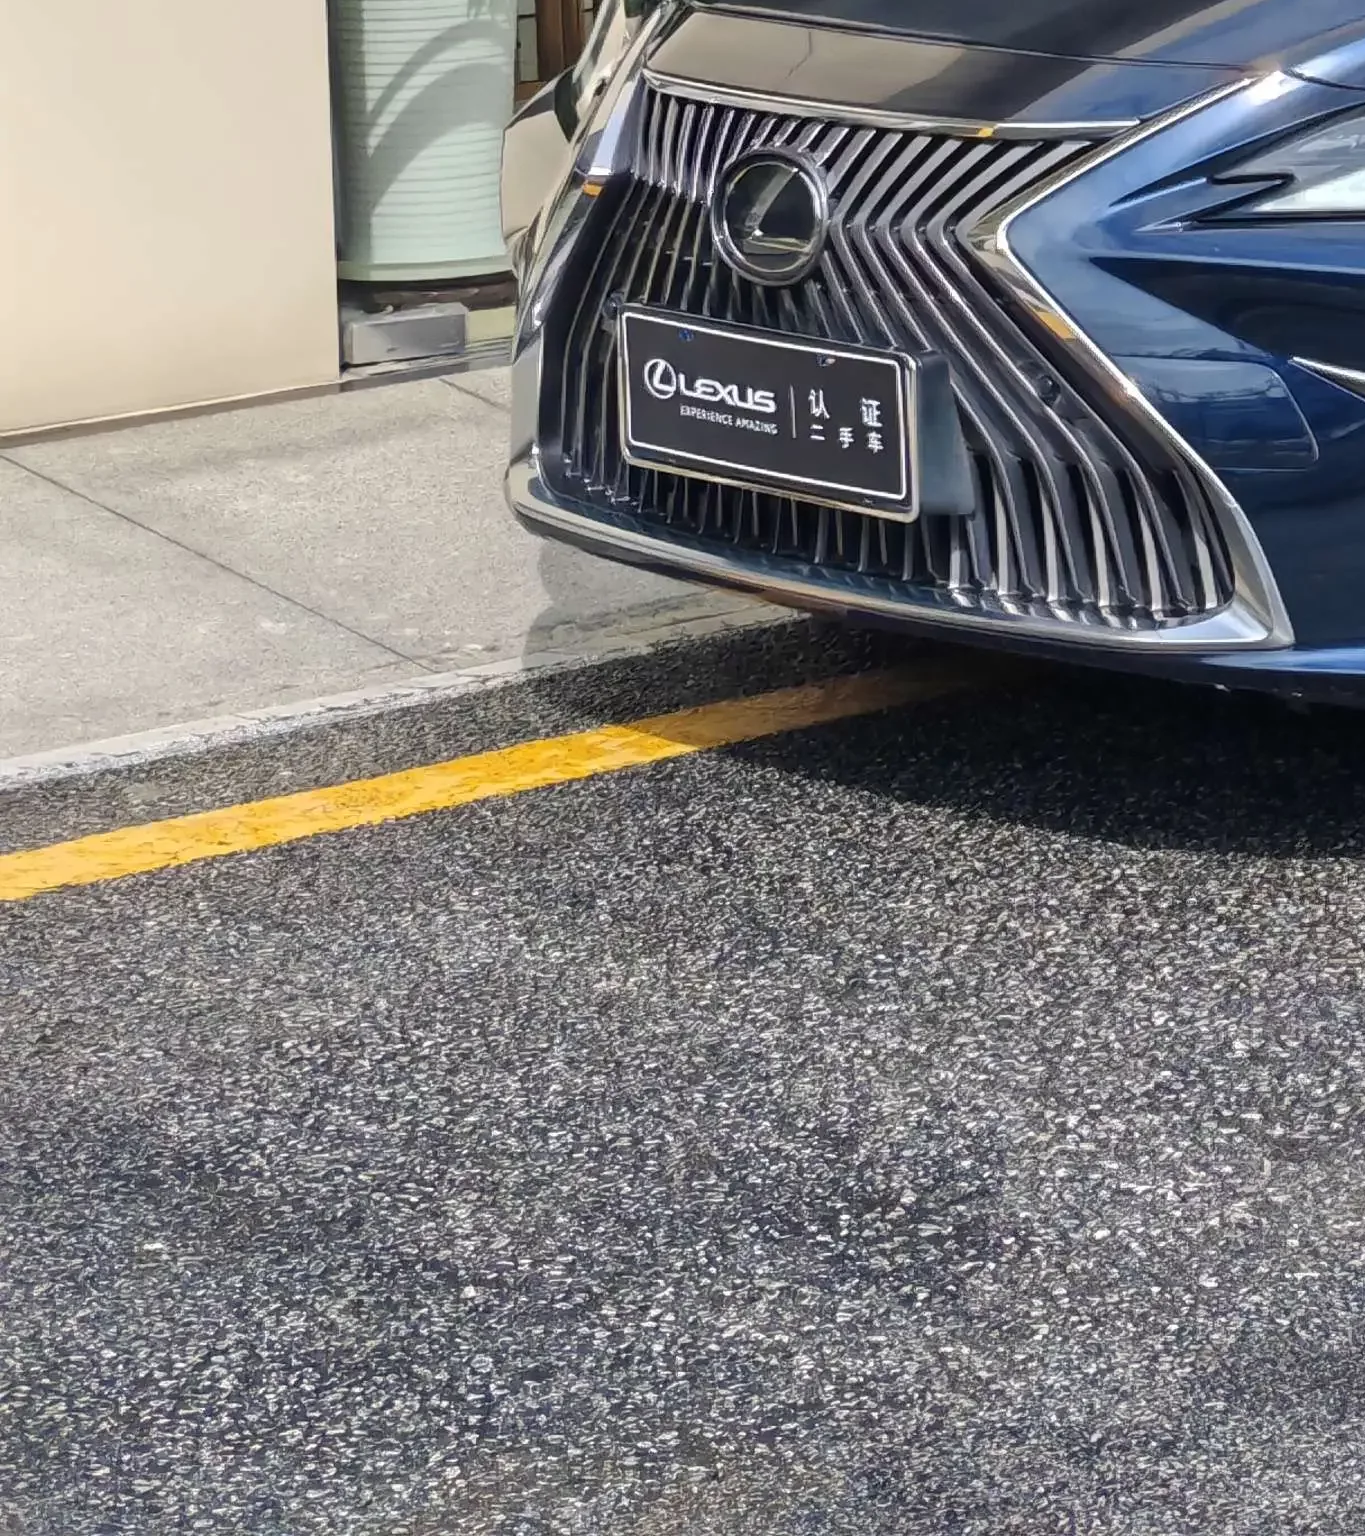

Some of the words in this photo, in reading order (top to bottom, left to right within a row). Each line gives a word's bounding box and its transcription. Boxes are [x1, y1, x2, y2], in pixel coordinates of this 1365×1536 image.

[678, 372, 777, 413] LEXUS
[680, 405, 734, 426] EXPERIENCE
[735, 417, 778, 435] AMAZING
